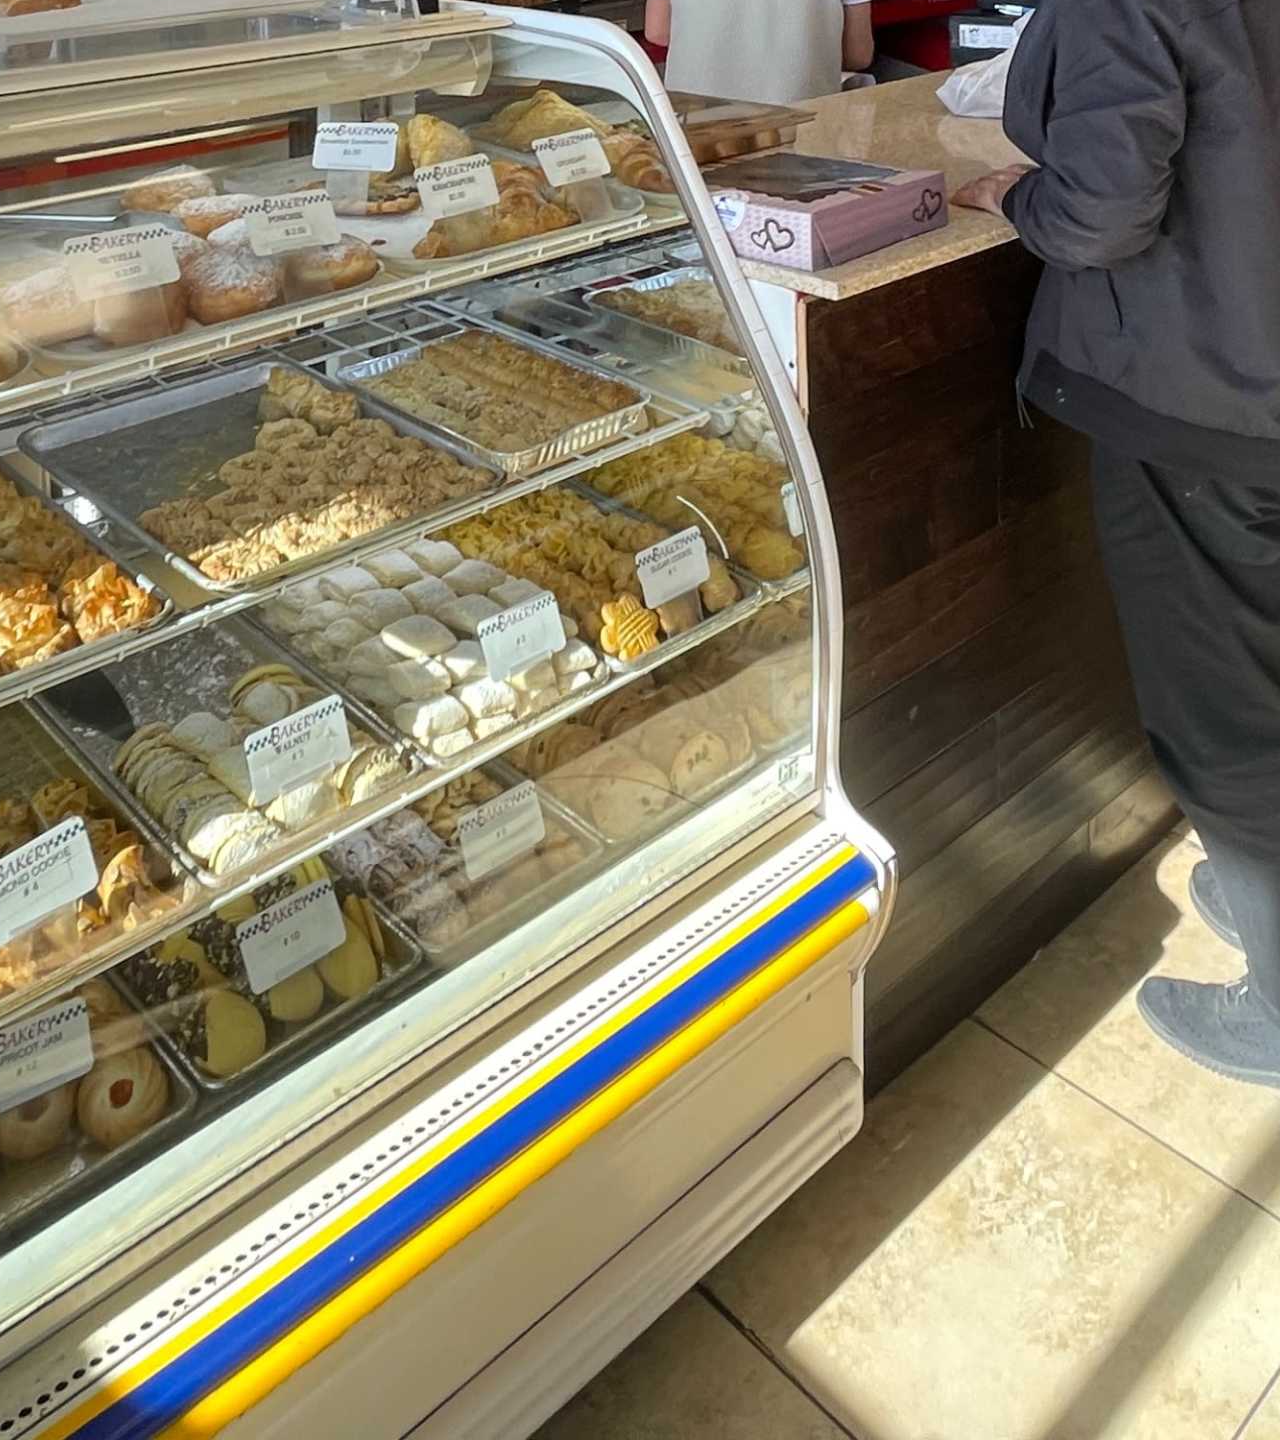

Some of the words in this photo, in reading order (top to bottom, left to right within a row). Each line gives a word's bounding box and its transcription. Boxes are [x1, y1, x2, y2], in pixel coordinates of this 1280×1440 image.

[263, 196, 306, 214] BAKERY
[90, 232, 142, 254] BAKERY
[497, 605, 536, 633] BAKERY
[270, 713, 318, 747] BAKERY
[274, 730, 312, 755] WALNUT
[31, 845, 72, 878] COOKIE
[259, 895, 308, 933] BAKERY
[41, 1031, 64, 1049] JAM
